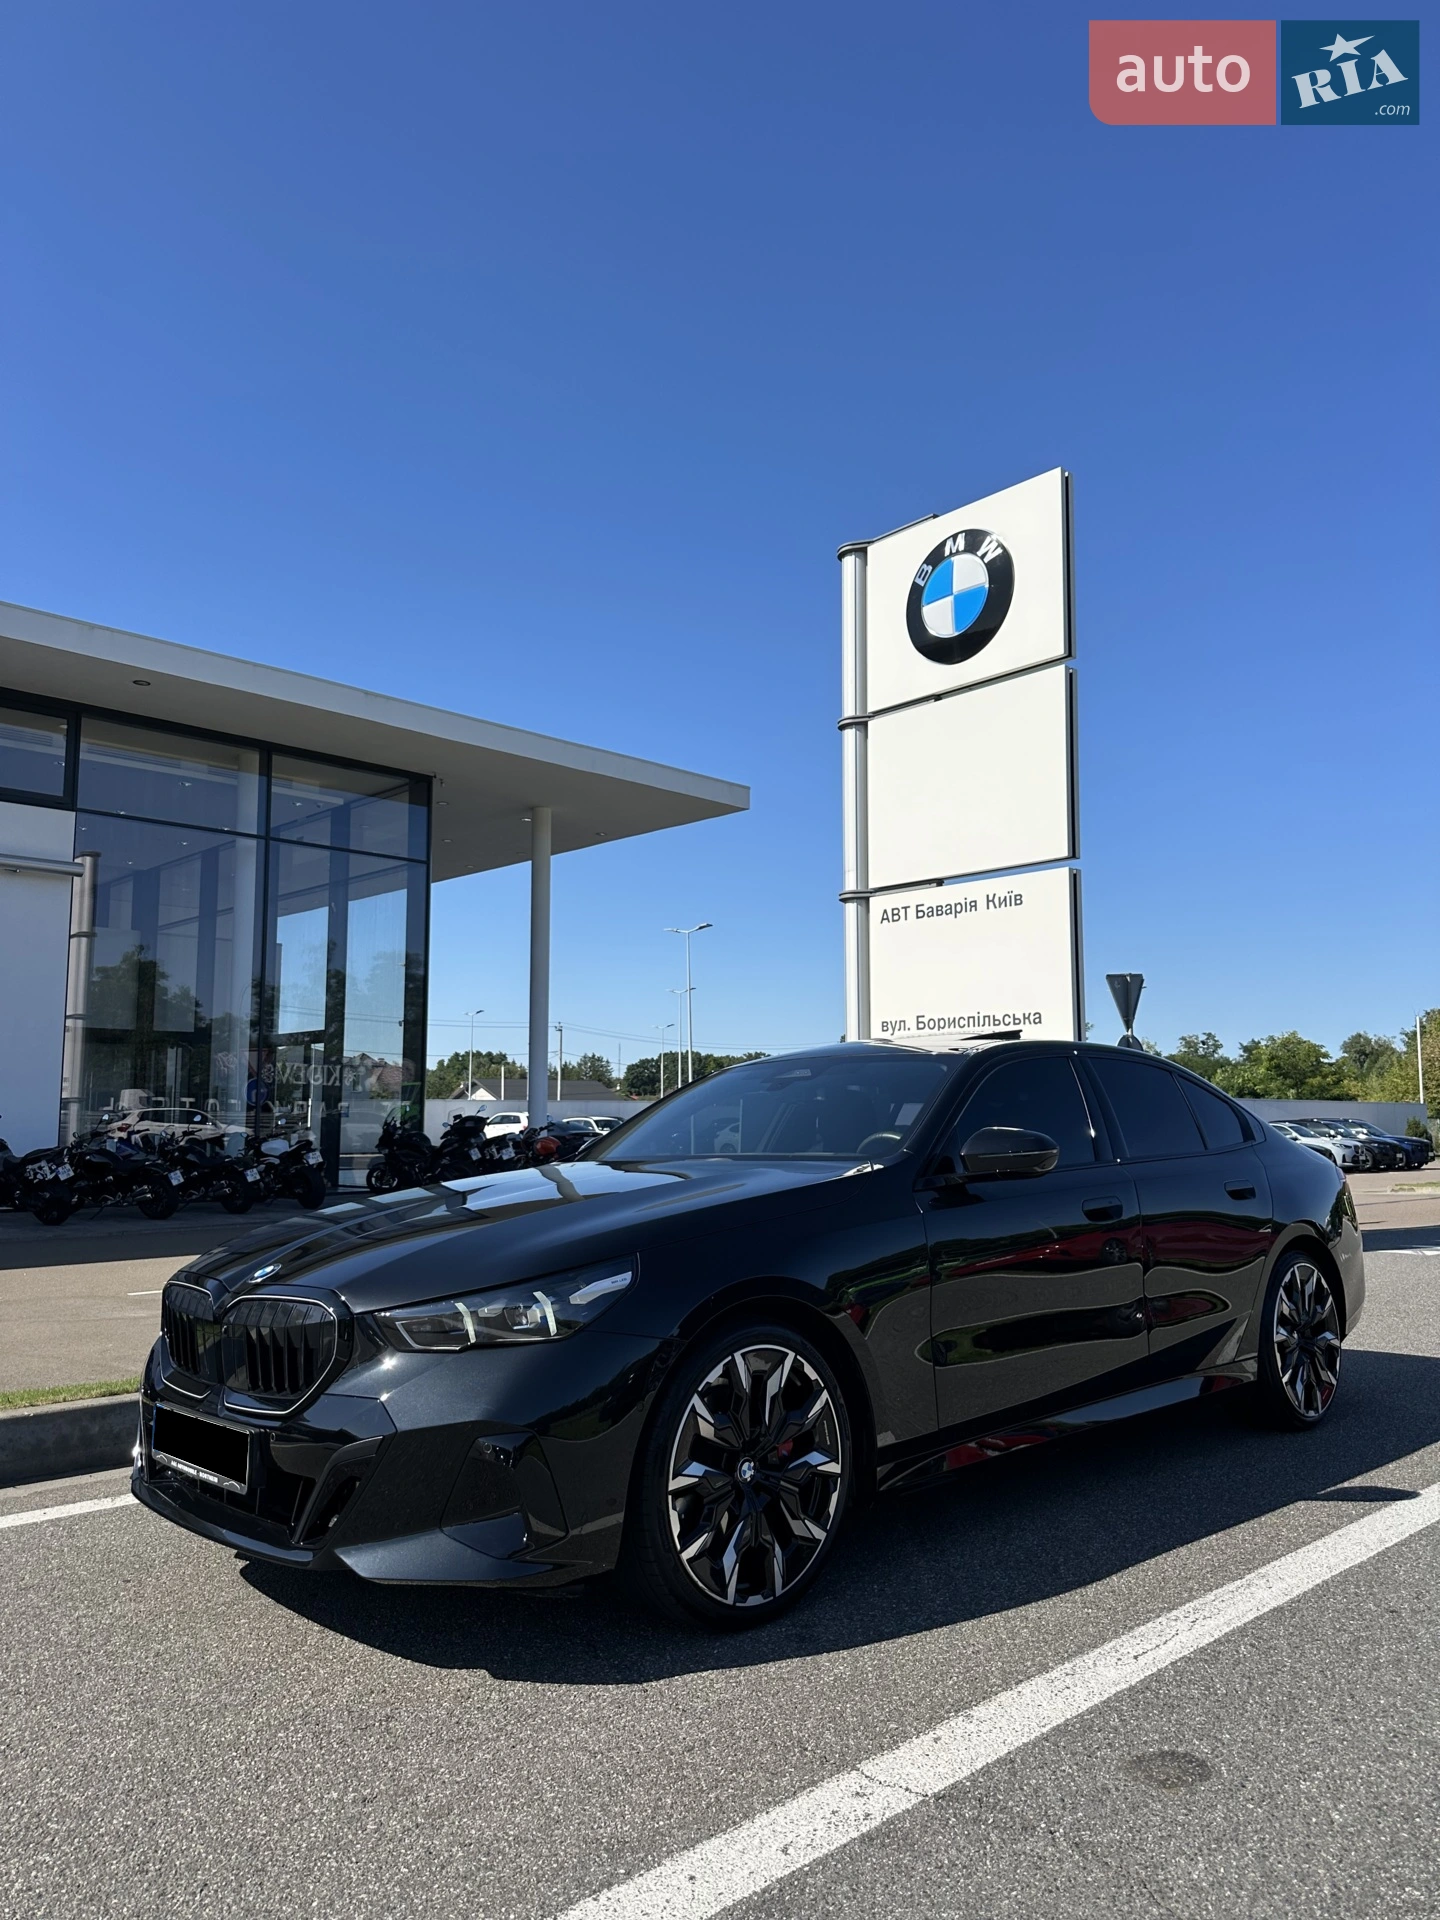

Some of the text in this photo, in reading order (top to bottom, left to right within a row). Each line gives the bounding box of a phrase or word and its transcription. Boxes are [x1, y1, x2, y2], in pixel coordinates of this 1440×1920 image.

[914, 532, 1004, 587] BMW
[880, 890, 1024, 924] АВТ Баварія Київ
[881, 1011, 1042, 1036] вул. Бориспільська
